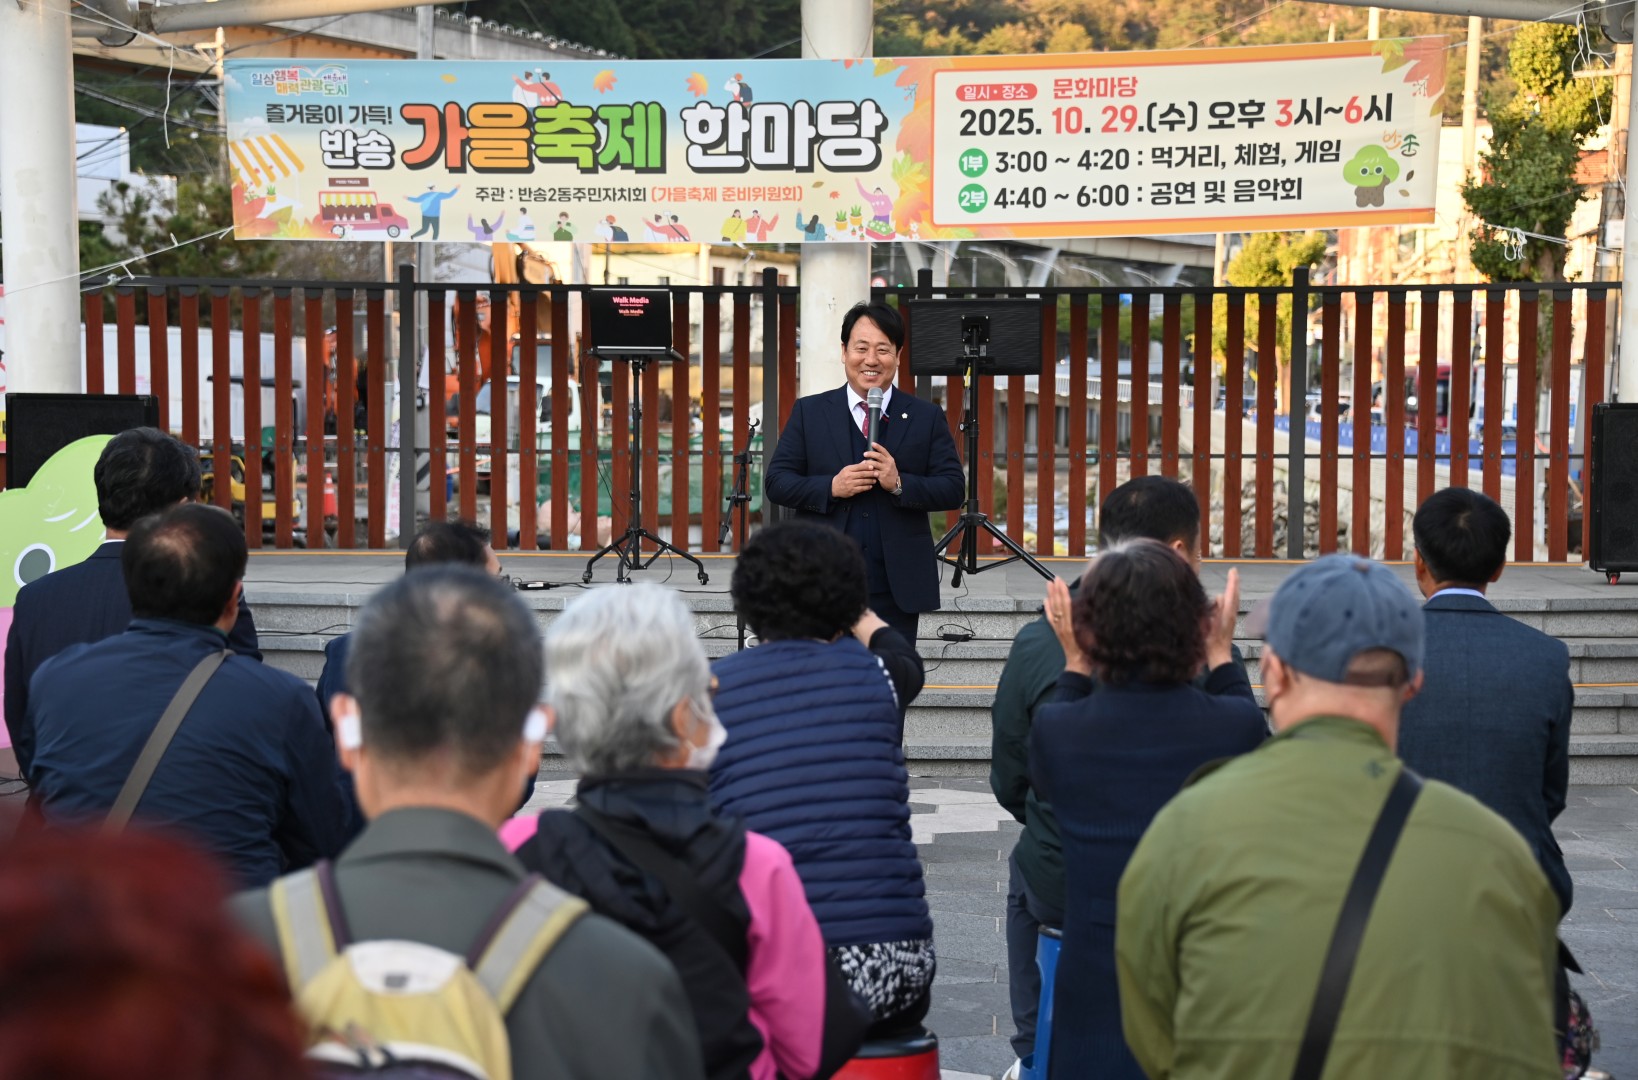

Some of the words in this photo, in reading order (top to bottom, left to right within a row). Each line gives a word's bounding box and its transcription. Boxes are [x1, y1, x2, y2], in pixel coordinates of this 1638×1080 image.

[1053, 76, 1138, 99] 문화마당
[266, 104, 343, 124] 즐거움이
[349, 104, 393, 125] 가득!
[960, 108, 1042, 136] 2025.
[1052, 106, 1091, 134] 10.
[1208, 99, 1265, 129] 오후
[1275, 92, 1393, 127] 3시~6시
[320, 129, 395, 170] 반송
[400, 100, 667, 174] 가을축제
[680, 98, 888, 174] 한마당
[961, 155, 983, 171] 1부
[995, 150, 1047, 173] 3:00
[1077, 148, 1129, 171] 4:20
[1151, 145, 1226, 170] 먹거리,
[1234, 141, 1286, 167] 체험,
[1294, 139, 1341, 164] 게임
[475, 187, 505, 203] 주관
[518, 186, 647, 203] 반송2동주민자치회
[651, 186, 717, 203] (가을축제
[722, 185, 803, 203] 준비위원회)
[960, 191, 986, 207] 2부
[993, 186, 1046, 209] 4:40
[1076, 184, 1129, 207] 6:00
[1151, 181, 1195, 206] 공연
[1204, 179, 1226, 204] 및
[1234, 177, 1303, 202] 음악회
[612, 296, 628, 304] Walk
[629, 296, 649, 304] Media
